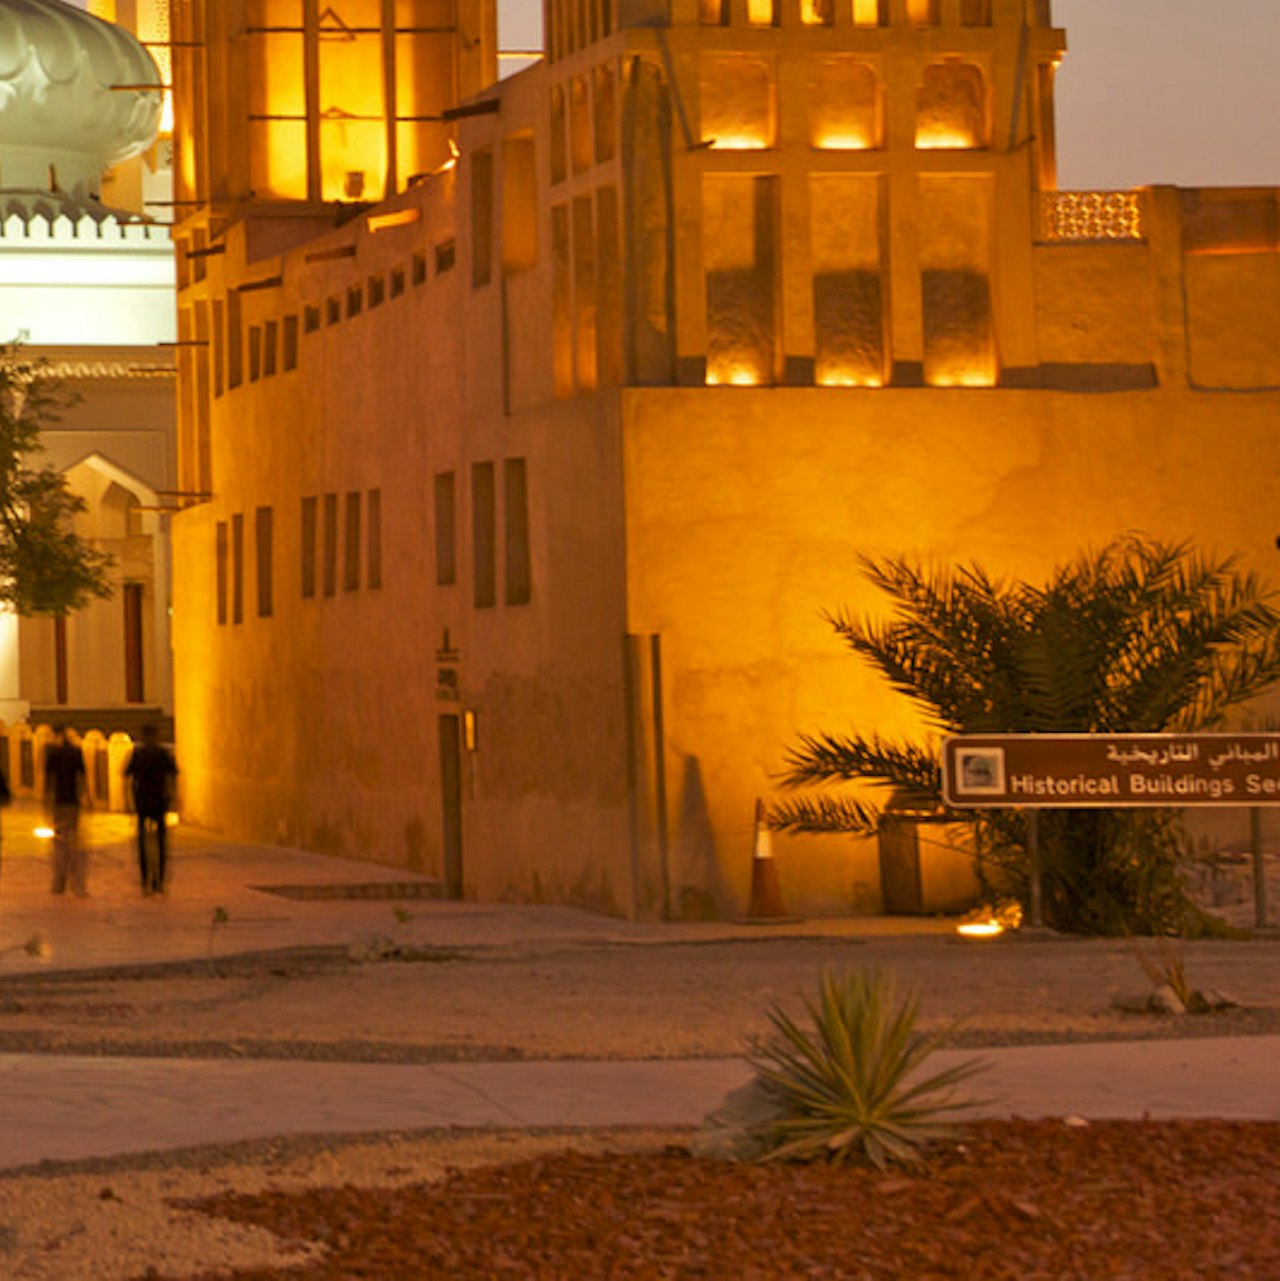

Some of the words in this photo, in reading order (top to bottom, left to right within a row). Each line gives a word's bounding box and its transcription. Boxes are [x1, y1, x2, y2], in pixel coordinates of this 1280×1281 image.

[1105, 742, 1199, 766] التاريخية
[1208, 742, 1279, 771] المباني
[1010, 774, 1120, 796] Historical
[1129, 773, 1236, 798] Buildings
[1245, 773, 1280, 795] Se
